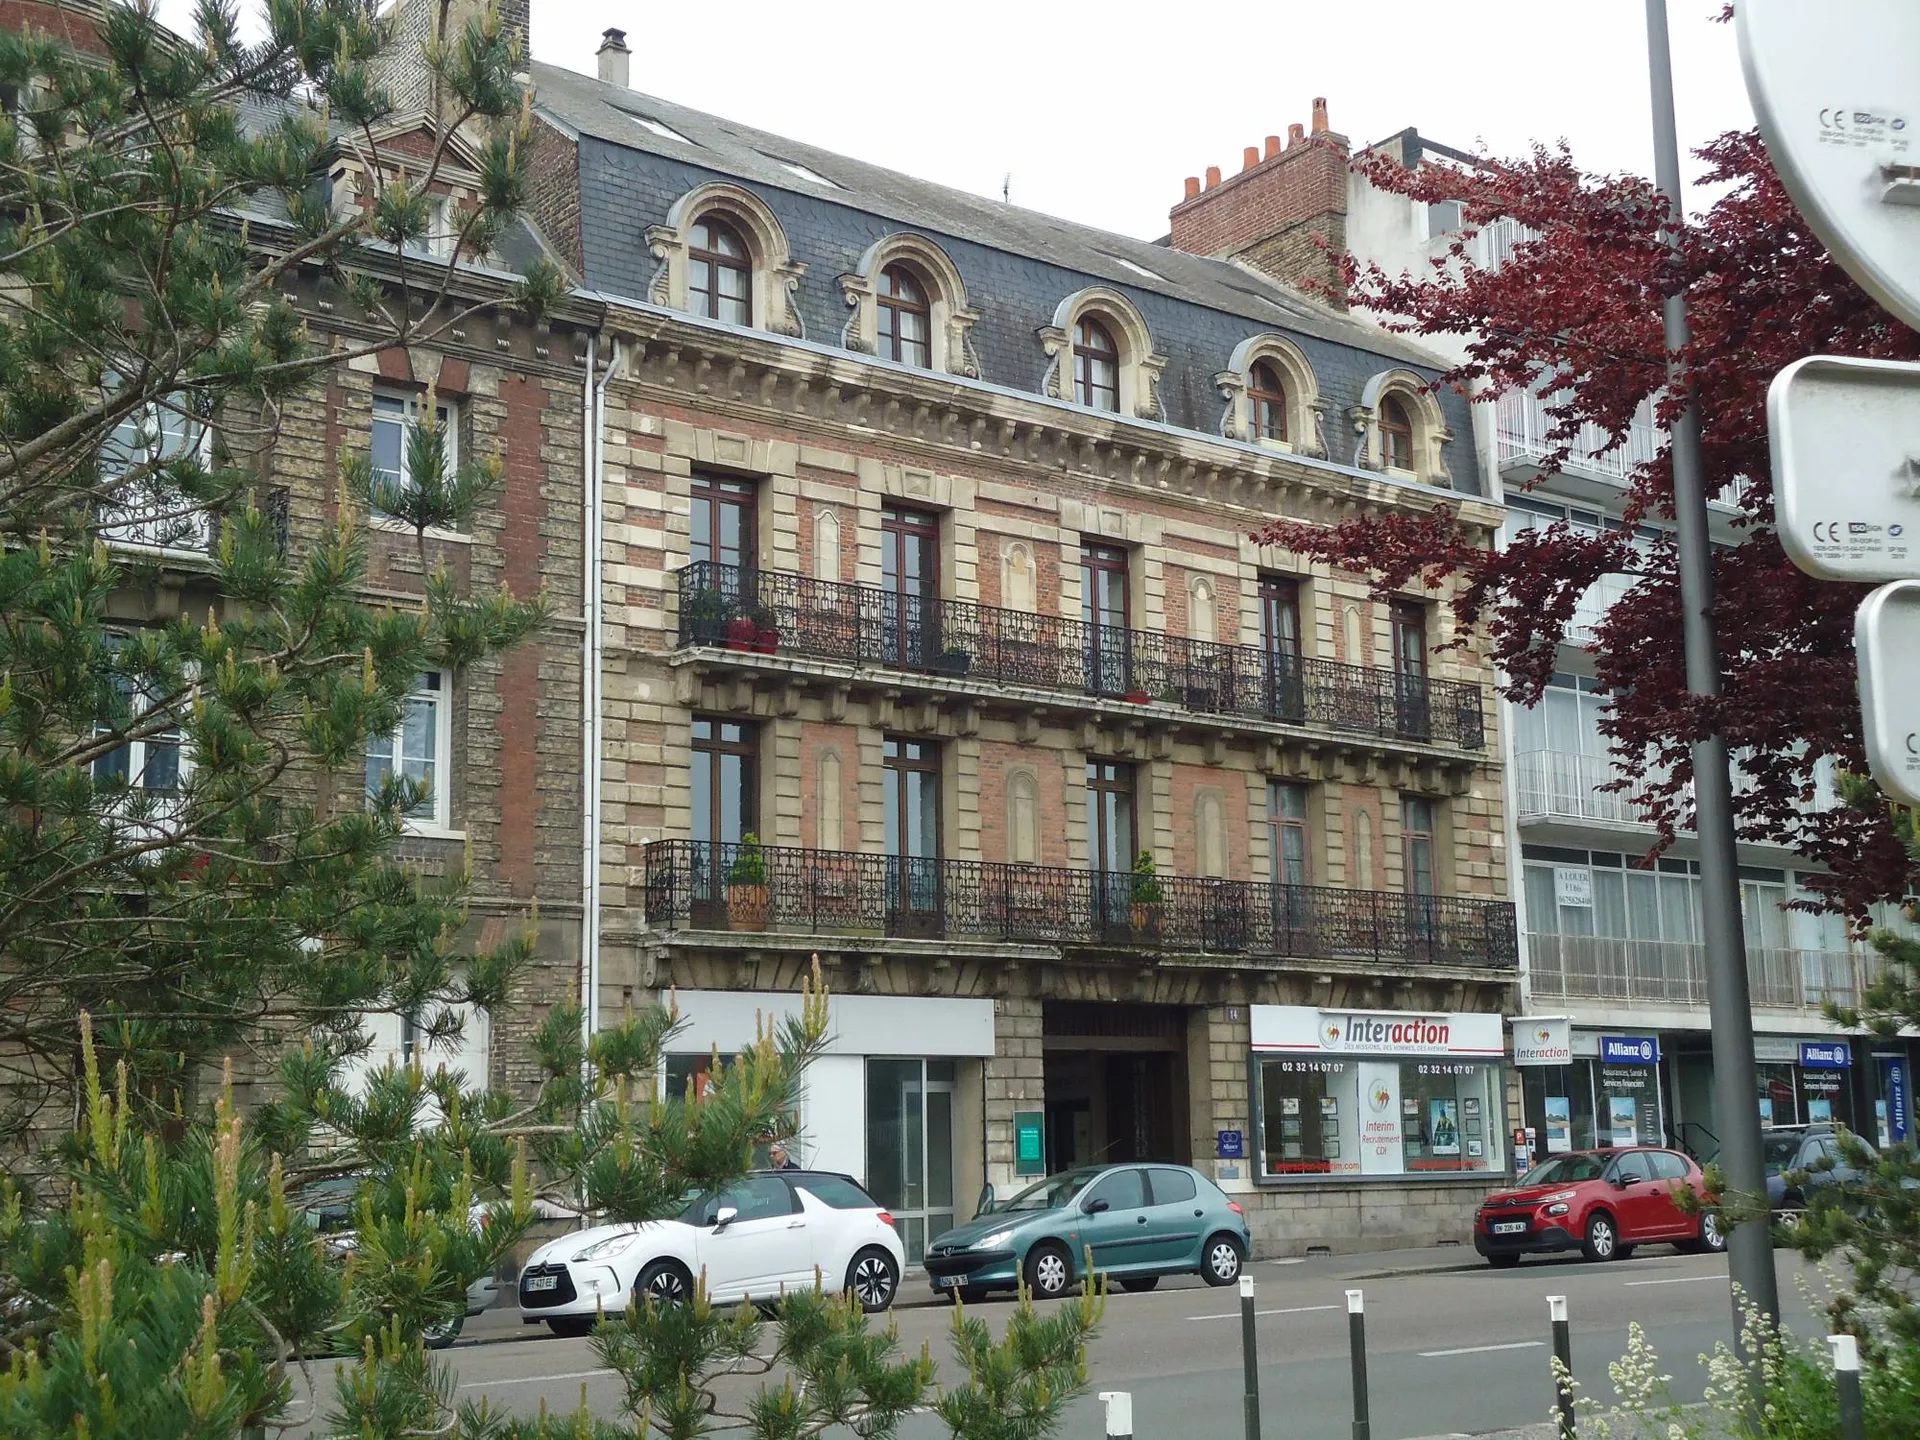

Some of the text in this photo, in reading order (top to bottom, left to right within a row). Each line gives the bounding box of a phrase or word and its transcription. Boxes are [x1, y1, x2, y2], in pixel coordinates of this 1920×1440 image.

[1819, 108, 1845, 130] CE
[1813, 522, 1840, 543] CE
[1565, 872, 1589, 882] LOUER
[1345, 1016, 1450, 1044] Interaction
[1517, 1047, 1568, 1058] Interaction
[1608, 1042, 1639, 1056] Allianz
[1806, 1048, 1833, 1060] Allianz
[1282, 1062, 1344, 1073] 02 32 14 07 07
[1418, 1064, 1474, 1075] 02 32 14 07 07
[1895, 1086, 1904, 1130] Allianz
[1362, 1135, 1400, 1143] Recrutement
